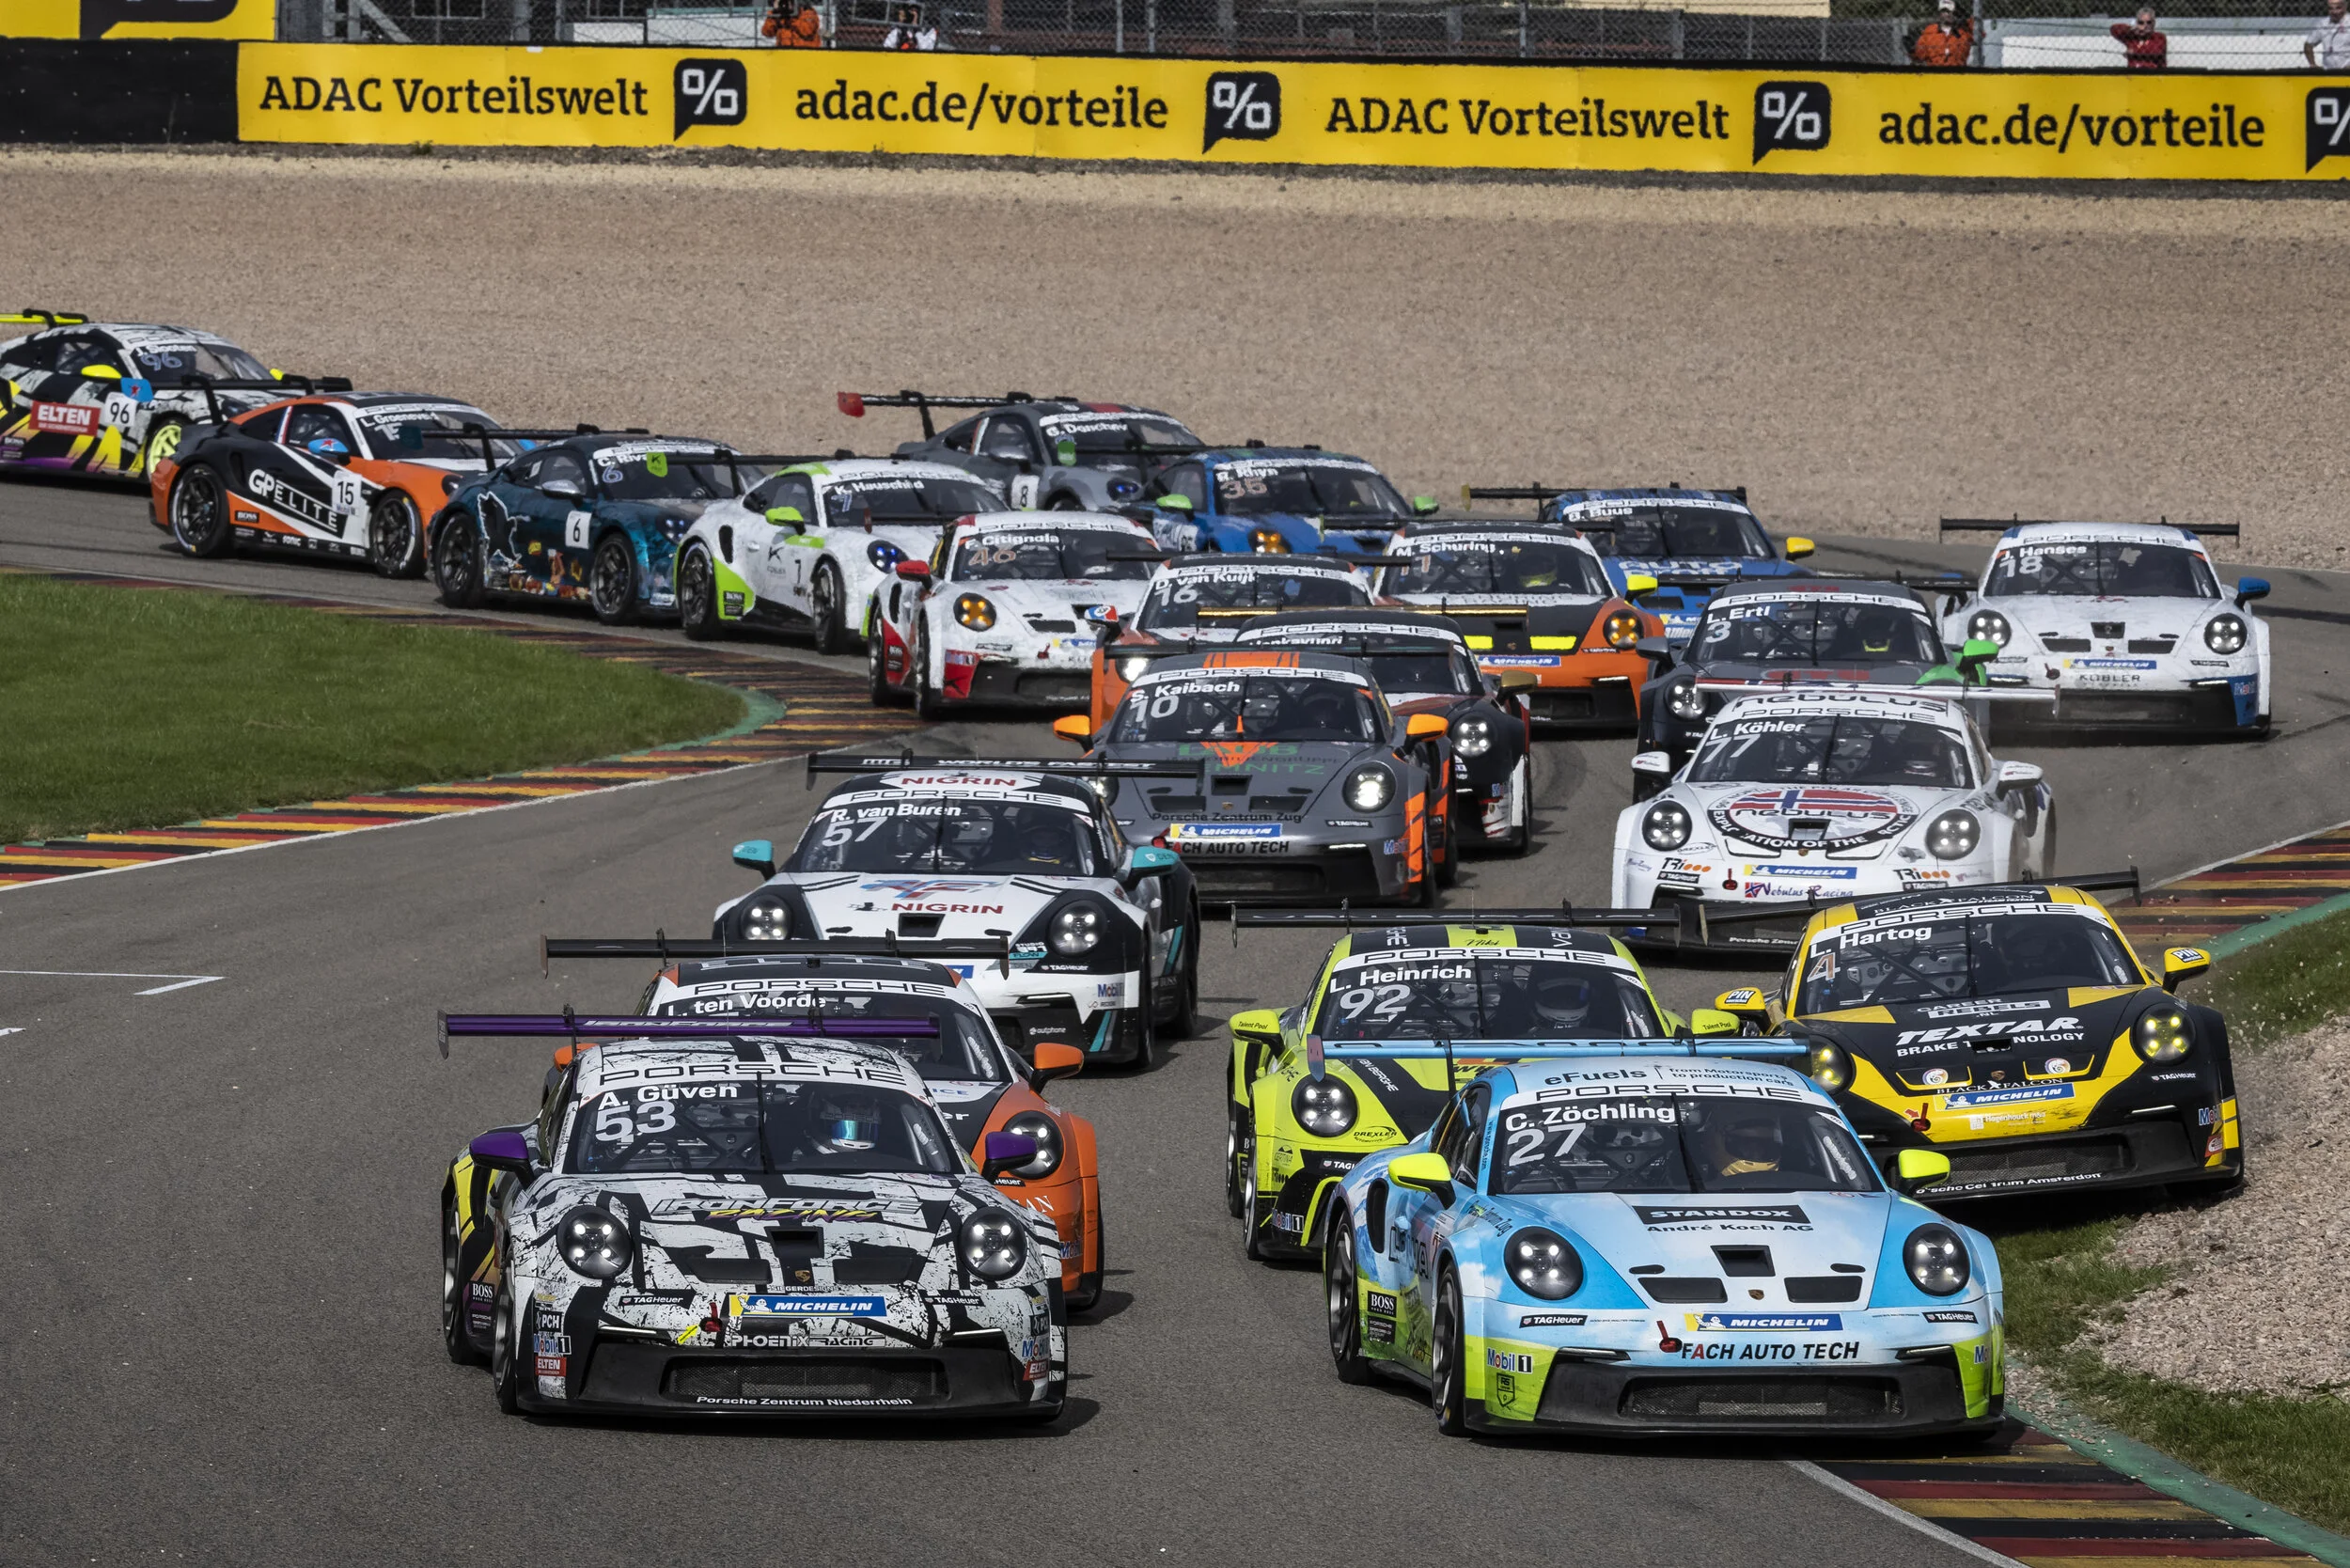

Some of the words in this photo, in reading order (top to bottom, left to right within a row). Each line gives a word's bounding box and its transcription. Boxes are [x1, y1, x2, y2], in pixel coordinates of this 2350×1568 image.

[259, 75, 382, 113] ADAC
[396, 75, 649, 117] Vorteilswelt
[682, 68, 740, 117] %
[795, 79, 1168, 131] adac.de/vorteile
[1213, 81, 1271, 130] %
[1324, 98, 1449, 134] ADAC
[1459, 97, 1730, 139] Vorteilswelt
[1762, 91, 1822, 140] %
[1879, 102, 2264, 153] adac.de/vorteile
[140, 353, 182, 371] 96
[38, 404, 91, 425] ELTEN
[110, 401, 130, 423] 96
[602, 465, 623, 483] 6
[337, 481, 354, 505] 15
[1020, 485, 1028, 507] 8
[572, 518, 581, 541] 6
[979, 522, 1129, 532] PORSCHE
[965, 539, 979, 549] F.
[2024, 534, 2183, 546] PORSCHE
[968, 548, 1017, 566] 46
[1396, 547, 1415, 557] M.
[1419, 541, 1496, 554] Schuring
[2000, 549, 2014, 560] J.
[2019, 545, 2088, 557] Hanses
[1999, 556, 2044, 578] 18
[1155, 578, 1172, 589] D.
[1177, 573, 1211, 585] van
[1154, 584, 1198, 606] 16
[1729, 592, 1903, 606] PORSCHE
[1707, 611, 1727, 624] L.
[1730, 605, 1771, 620] Ertl
[1261, 623, 1440, 637] PORSCHE
[1705, 620, 1731, 643] 3
[1159, 667, 1346, 681] PORSCHE
[1131, 689, 1150, 702] S.
[1155, 682, 1241, 698] Kaibach
[1129, 696, 1180, 723] 10
[1742, 707, 1935, 722] PORSCHE
[1710, 728, 1728, 741] L.
[1734, 720, 1807, 735] Köhler
[1702, 733, 1762, 763] 77
[901, 776, 1017, 787] NIGRIN
[850, 790, 1062, 805] PORSCHE
[831, 809, 850, 823] R.
[857, 806, 894, 818] van
[898, 804, 962, 817] Buren
[1152, 812, 1210, 823] Porsche
[1212, 812, 1273, 823] Zentrum
[1276, 812, 1302, 824] Zug
[822, 816, 886, 846] 57
[1201, 827, 1273, 836] MICHELIN
[1207, 841, 1251, 854] AUTO
[1253, 840, 1291, 854] TECH
[1834, 836, 1867, 847] THE
[1776, 868, 1848, 876] MICHELIN
[1758, 883, 1804, 897] Nebulus
[1809, 886, 1854, 898] Racing
[891, 902, 1004, 915] NIGRIN
[1841, 904, 2076, 933] PORSCHE
[1810, 942, 1836, 959] L.
[1840, 926, 1933, 949] Hartog
[1364, 949, 1606, 964] PORSCHE
[2174, 949, 2200, 959] PIN
[1807, 951, 1840, 982] 4
[1330, 977, 1351, 994] L.
[1359, 964, 1472, 986] Heinrich
[695, 980, 946, 996] PORSCHE
[1728, 990, 1755, 999] PIN
[694, 998, 733, 1014] ten
[739, 995, 826, 1010] Voorde
[1340, 984, 1410, 1019] 92
[1917, 998, 2003, 1012] CAREER
[1937, 1001, 2043, 1017] REBELS
[1895, 1016, 2080, 1045] TEXTAR
[1897, 1043, 1958, 1058] BRAKE
[600, 1063, 907, 1086] PORSCHE
[1544, 1068, 1648, 1085] eFuels
[1703, 1068, 1789, 1081] Motorsports
[1689, 1073, 1770, 1086] production
[1773, 1078, 1794, 1087] cars
[2160, 1072, 2197, 1080] TAGHeuer
[1536, 1084, 1802, 1101] PORSCHE
[1936, 1084, 1988, 1094] BLACK
[2001, 1077, 2064, 1090] FALCON
[598, 1091, 628, 1110] A.
[637, 1084, 738, 1104] Güven
[1975, 1088, 2062, 1103] MICHELIN
[595, 1101, 676, 1142] 53
[1505, 1113, 1534, 1132] C.
[1543, 1104, 1676, 1127] Zöchling
[1509, 1123, 1587, 1167] 27
[652, 1198, 924, 1215] IRONFORCE
[1650, 1208, 1793, 1219] STANDOX
[1647, 1222, 1714, 1232] André
[1719, 1223, 1776, 1231] Koch
[1782, 1223, 1814, 1232] AG
[472, 1283, 494, 1298] BOSS
[634, 1295, 683, 1304] TAGHeuer
[775, 1302, 872, 1311] MICHELIN
[935, 1296, 980, 1305] TAGHeuer
[1371, 1294, 1395, 1310] BOSS
[541, 1314, 560, 1329] PCH
[1533, 1316, 1583, 1325] TAGHeuer
[1730, 1317, 1829, 1327] MICHELIN
[1935, 1312, 1975, 1322] TAGHeuer
[534, 1334, 556, 1354] Mobil
[1682, 1341, 1735, 1360] FACH
[1740, 1342, 1796, 1360] AUTO
[1802, 1341, 1860, 1359] TECH
[538, 1358, 561, 1370] ELTEN
[1487, 1347, 1515, 1372] Mobil
[697, 1396, 758, 1405] Porsche
[760, 1398, 824, 1406] Zentrum
[826, 1397, 914, 1406] Niederrhein
